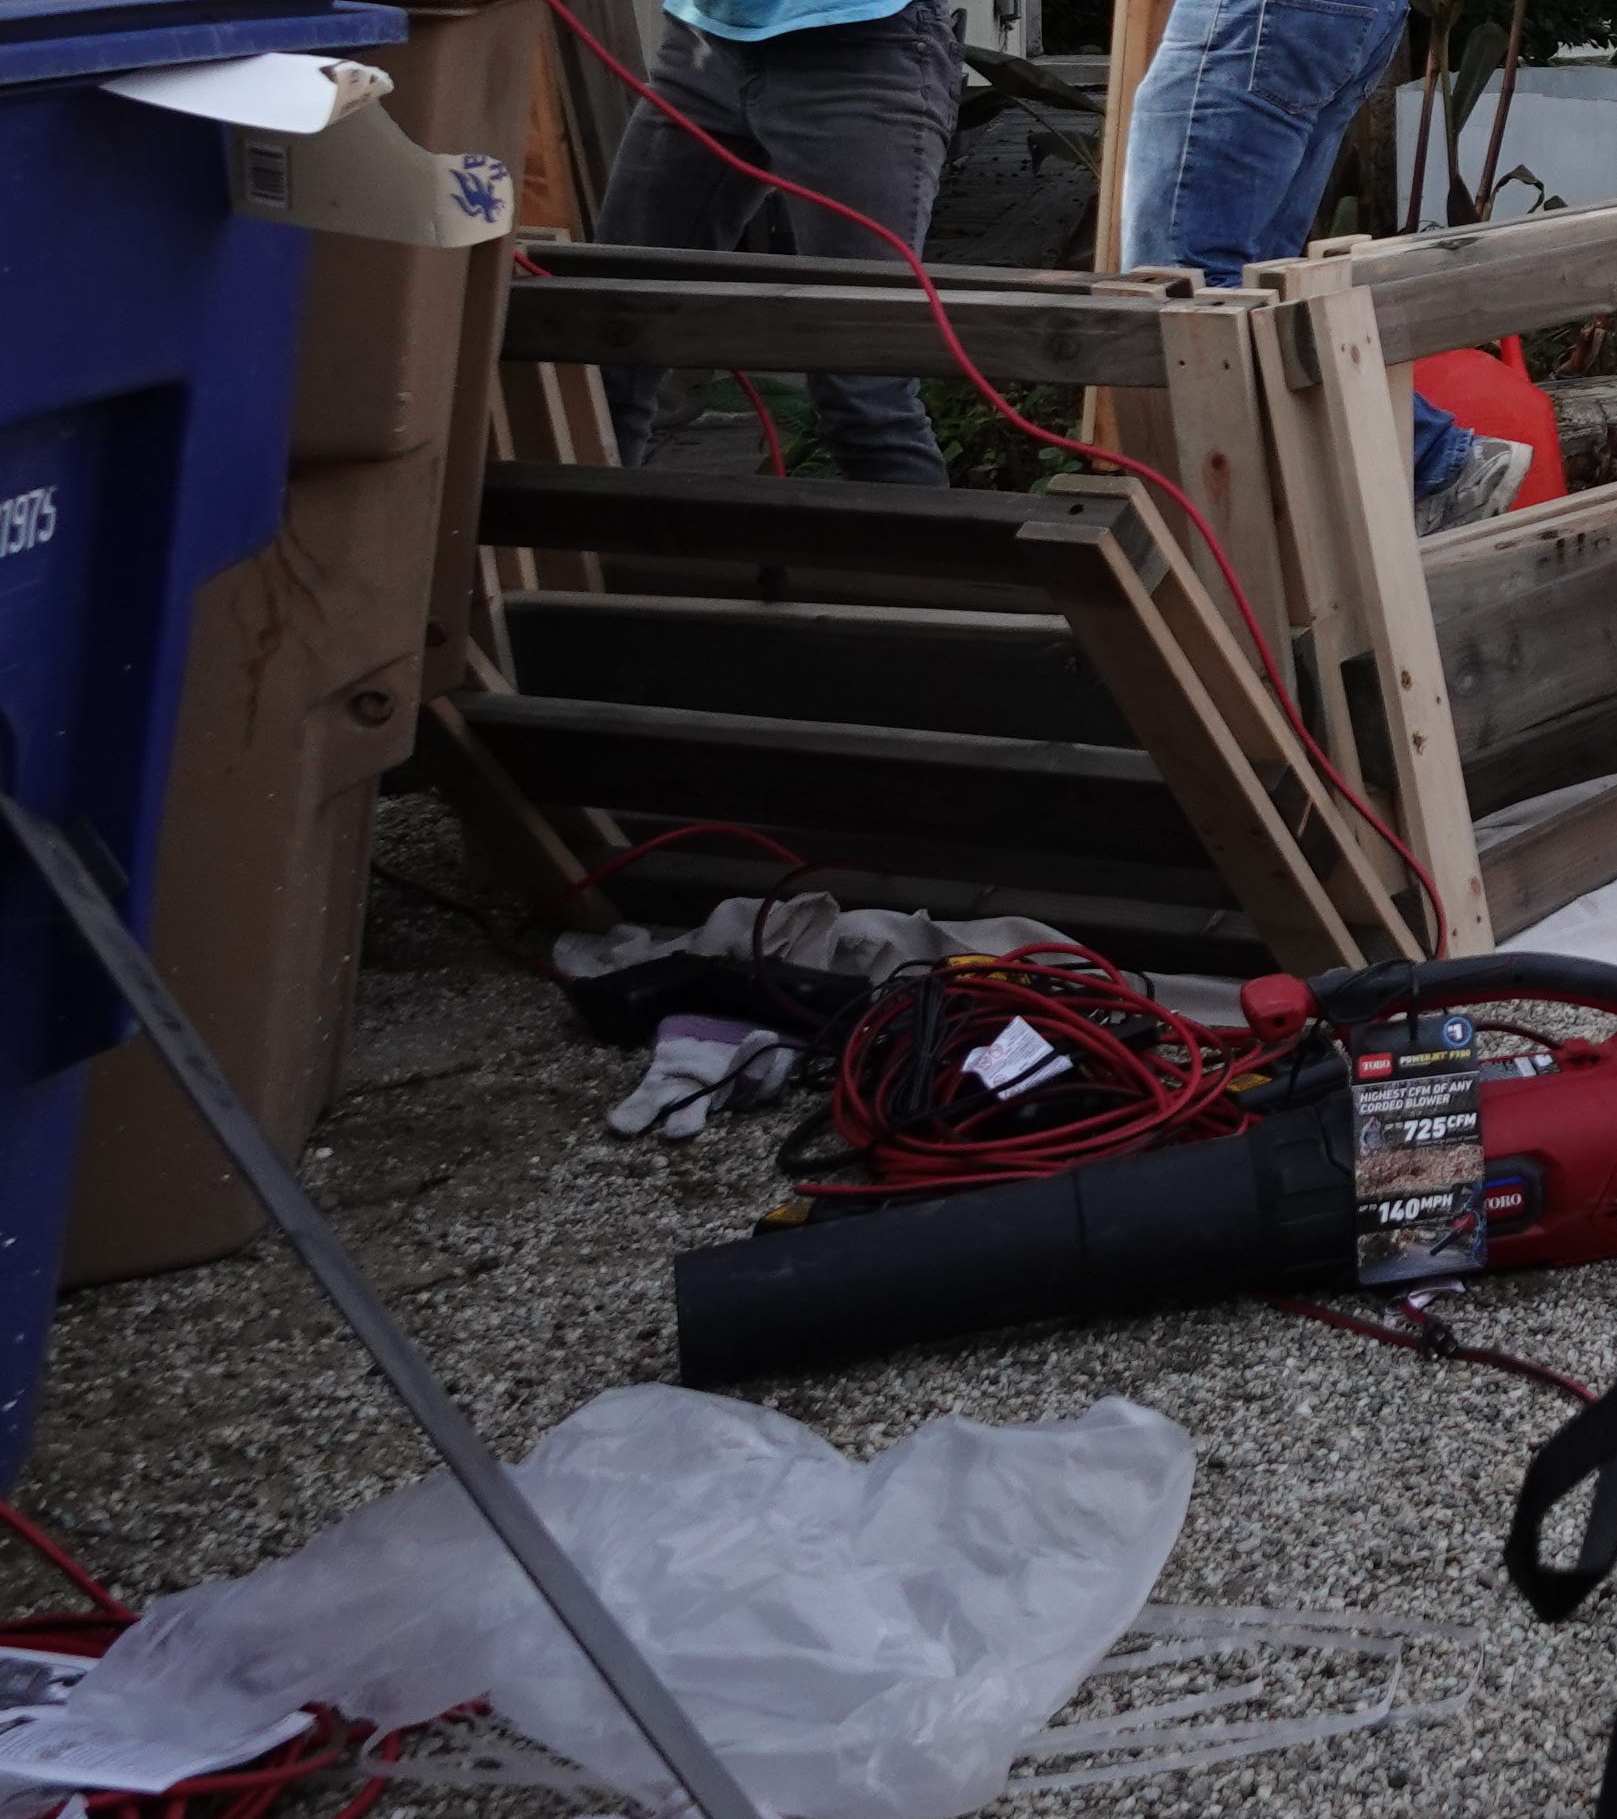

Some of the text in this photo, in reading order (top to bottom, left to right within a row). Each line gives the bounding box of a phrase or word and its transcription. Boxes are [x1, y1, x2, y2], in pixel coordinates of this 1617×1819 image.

[1360, 1080, 1473, 1102] HIGHEST CFM OF ANY
[1360, 1093, 1451, 1115] CORDED BLOWER
